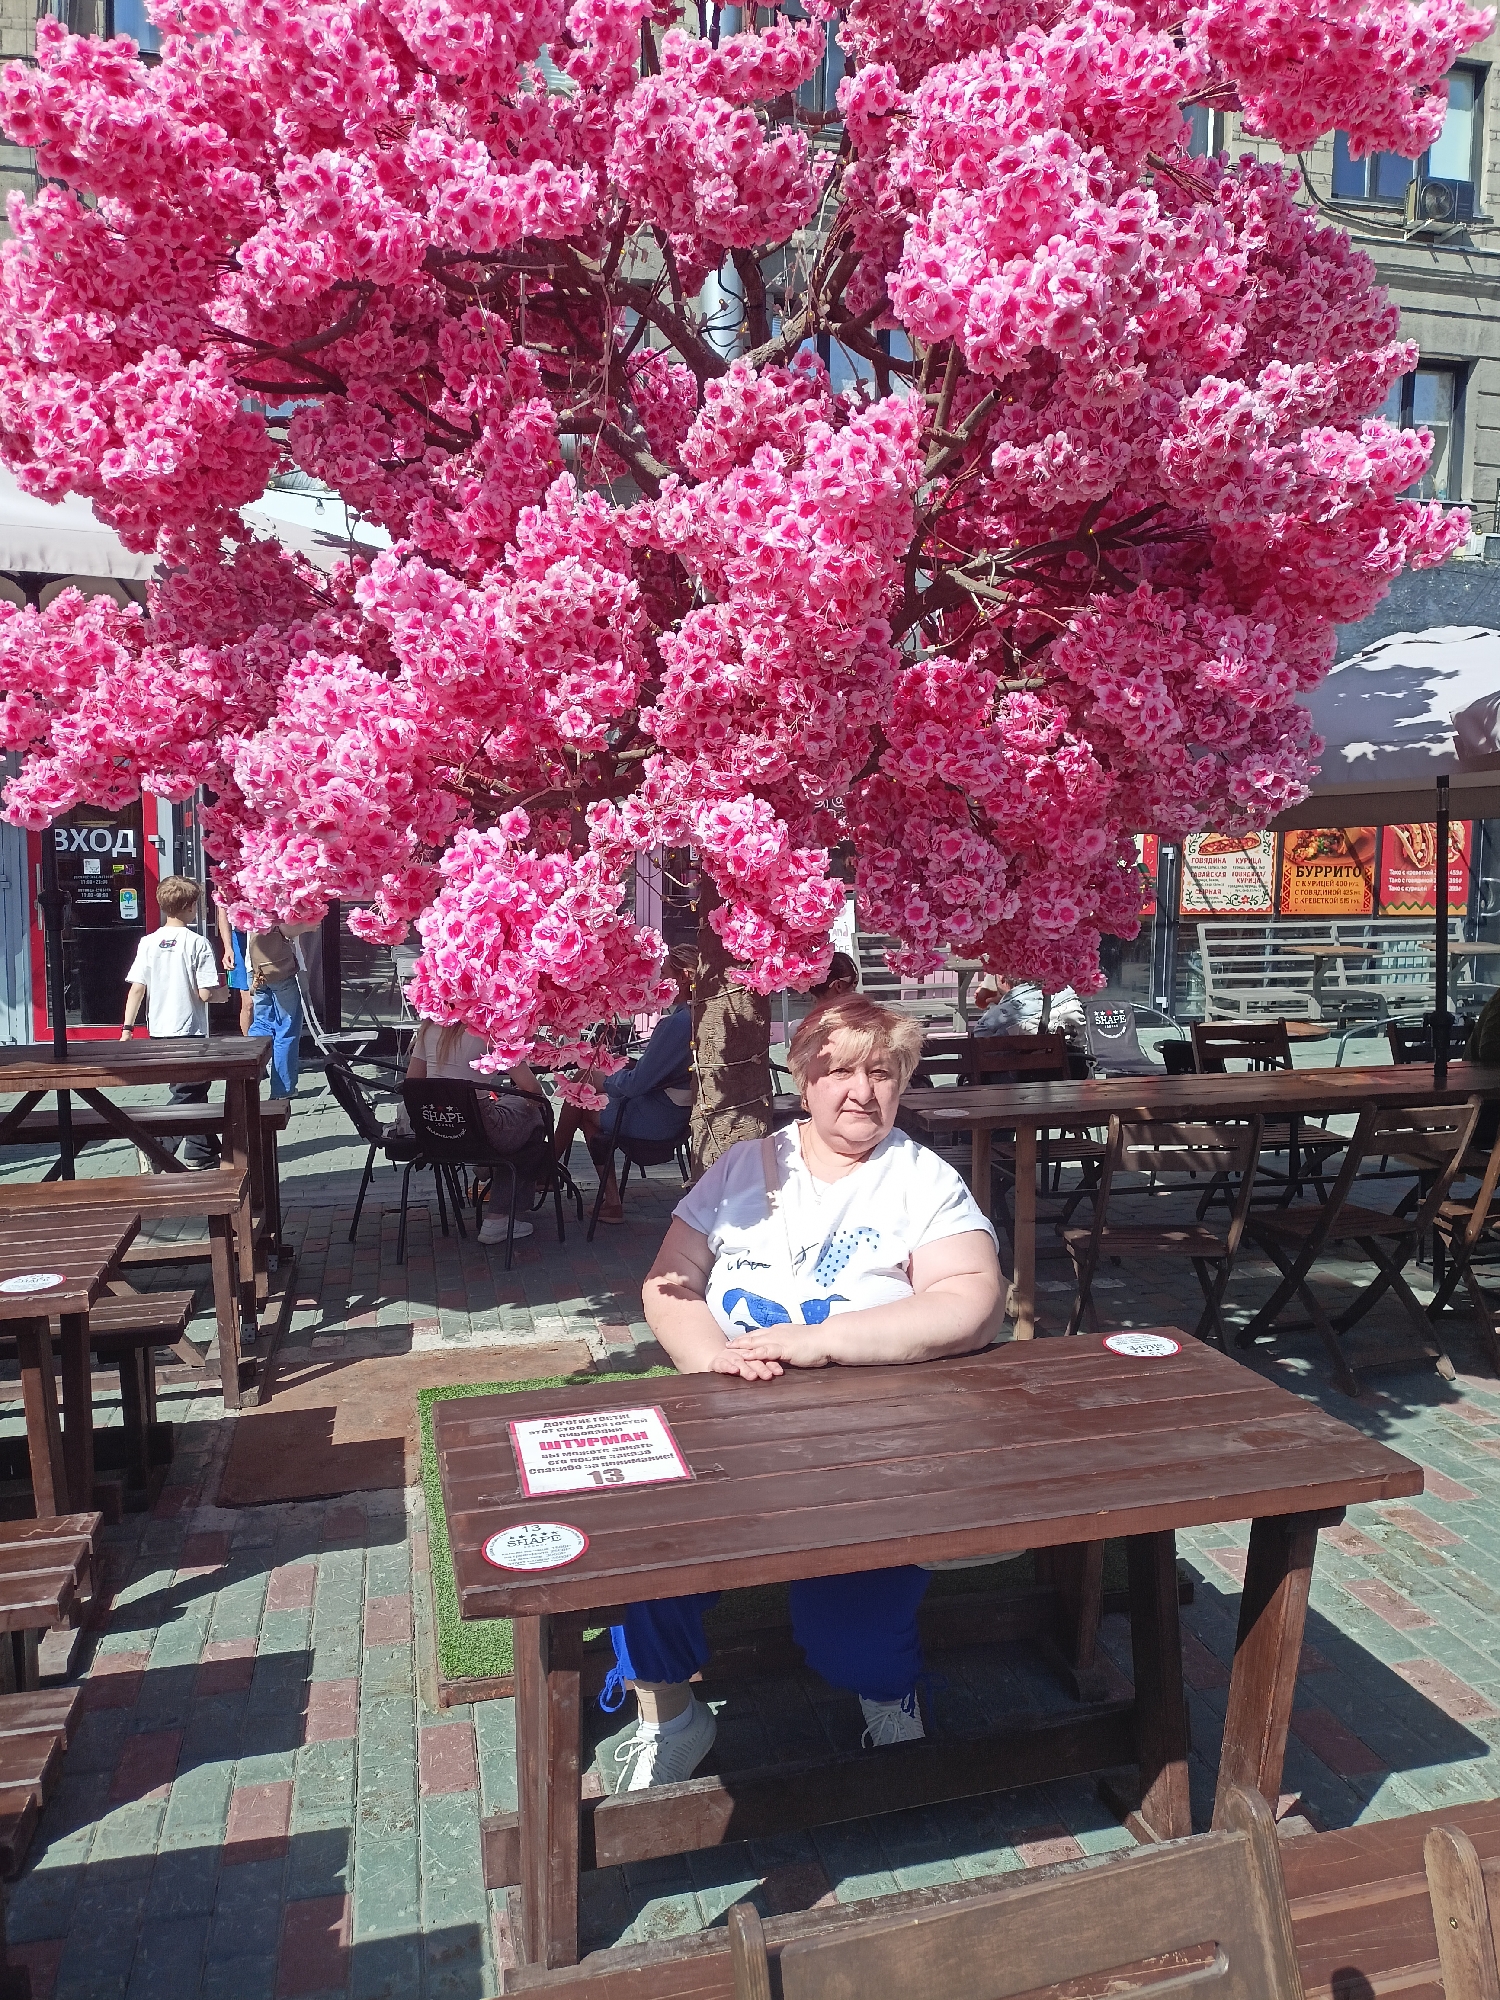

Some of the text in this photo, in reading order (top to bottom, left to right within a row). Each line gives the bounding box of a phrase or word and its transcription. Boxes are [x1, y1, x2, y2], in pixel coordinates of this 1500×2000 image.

[54, 828, 137, 858] ВХОД
[1191, 857, 1227, 865] ГОВЯДИНА
[1235, 857, 1262, 865] КУРИЦА
[1295, 865, 1362, 878] БУРРИТО
[1236, 877, 1261, 885] КУРИЦА
[1301, 879, 1334, 888] КУРИЦЕЙ
[1300, 888, 1341, 896] ГОВЯДИНОЙ
[1299, 896, 1338, 904] КРЕВЕТКОЙ
[1095, 1015, 1126, 1025] SHAPE
[422, 1110, 466, 1123] SHAPE
[539, 1431, 649, 1450] ШТУРМАН
[587, 1467, 626, 1484] 13
[521, 1524, 542, 1533] 13
[507, 1534, 562, 1547] SHAPE
